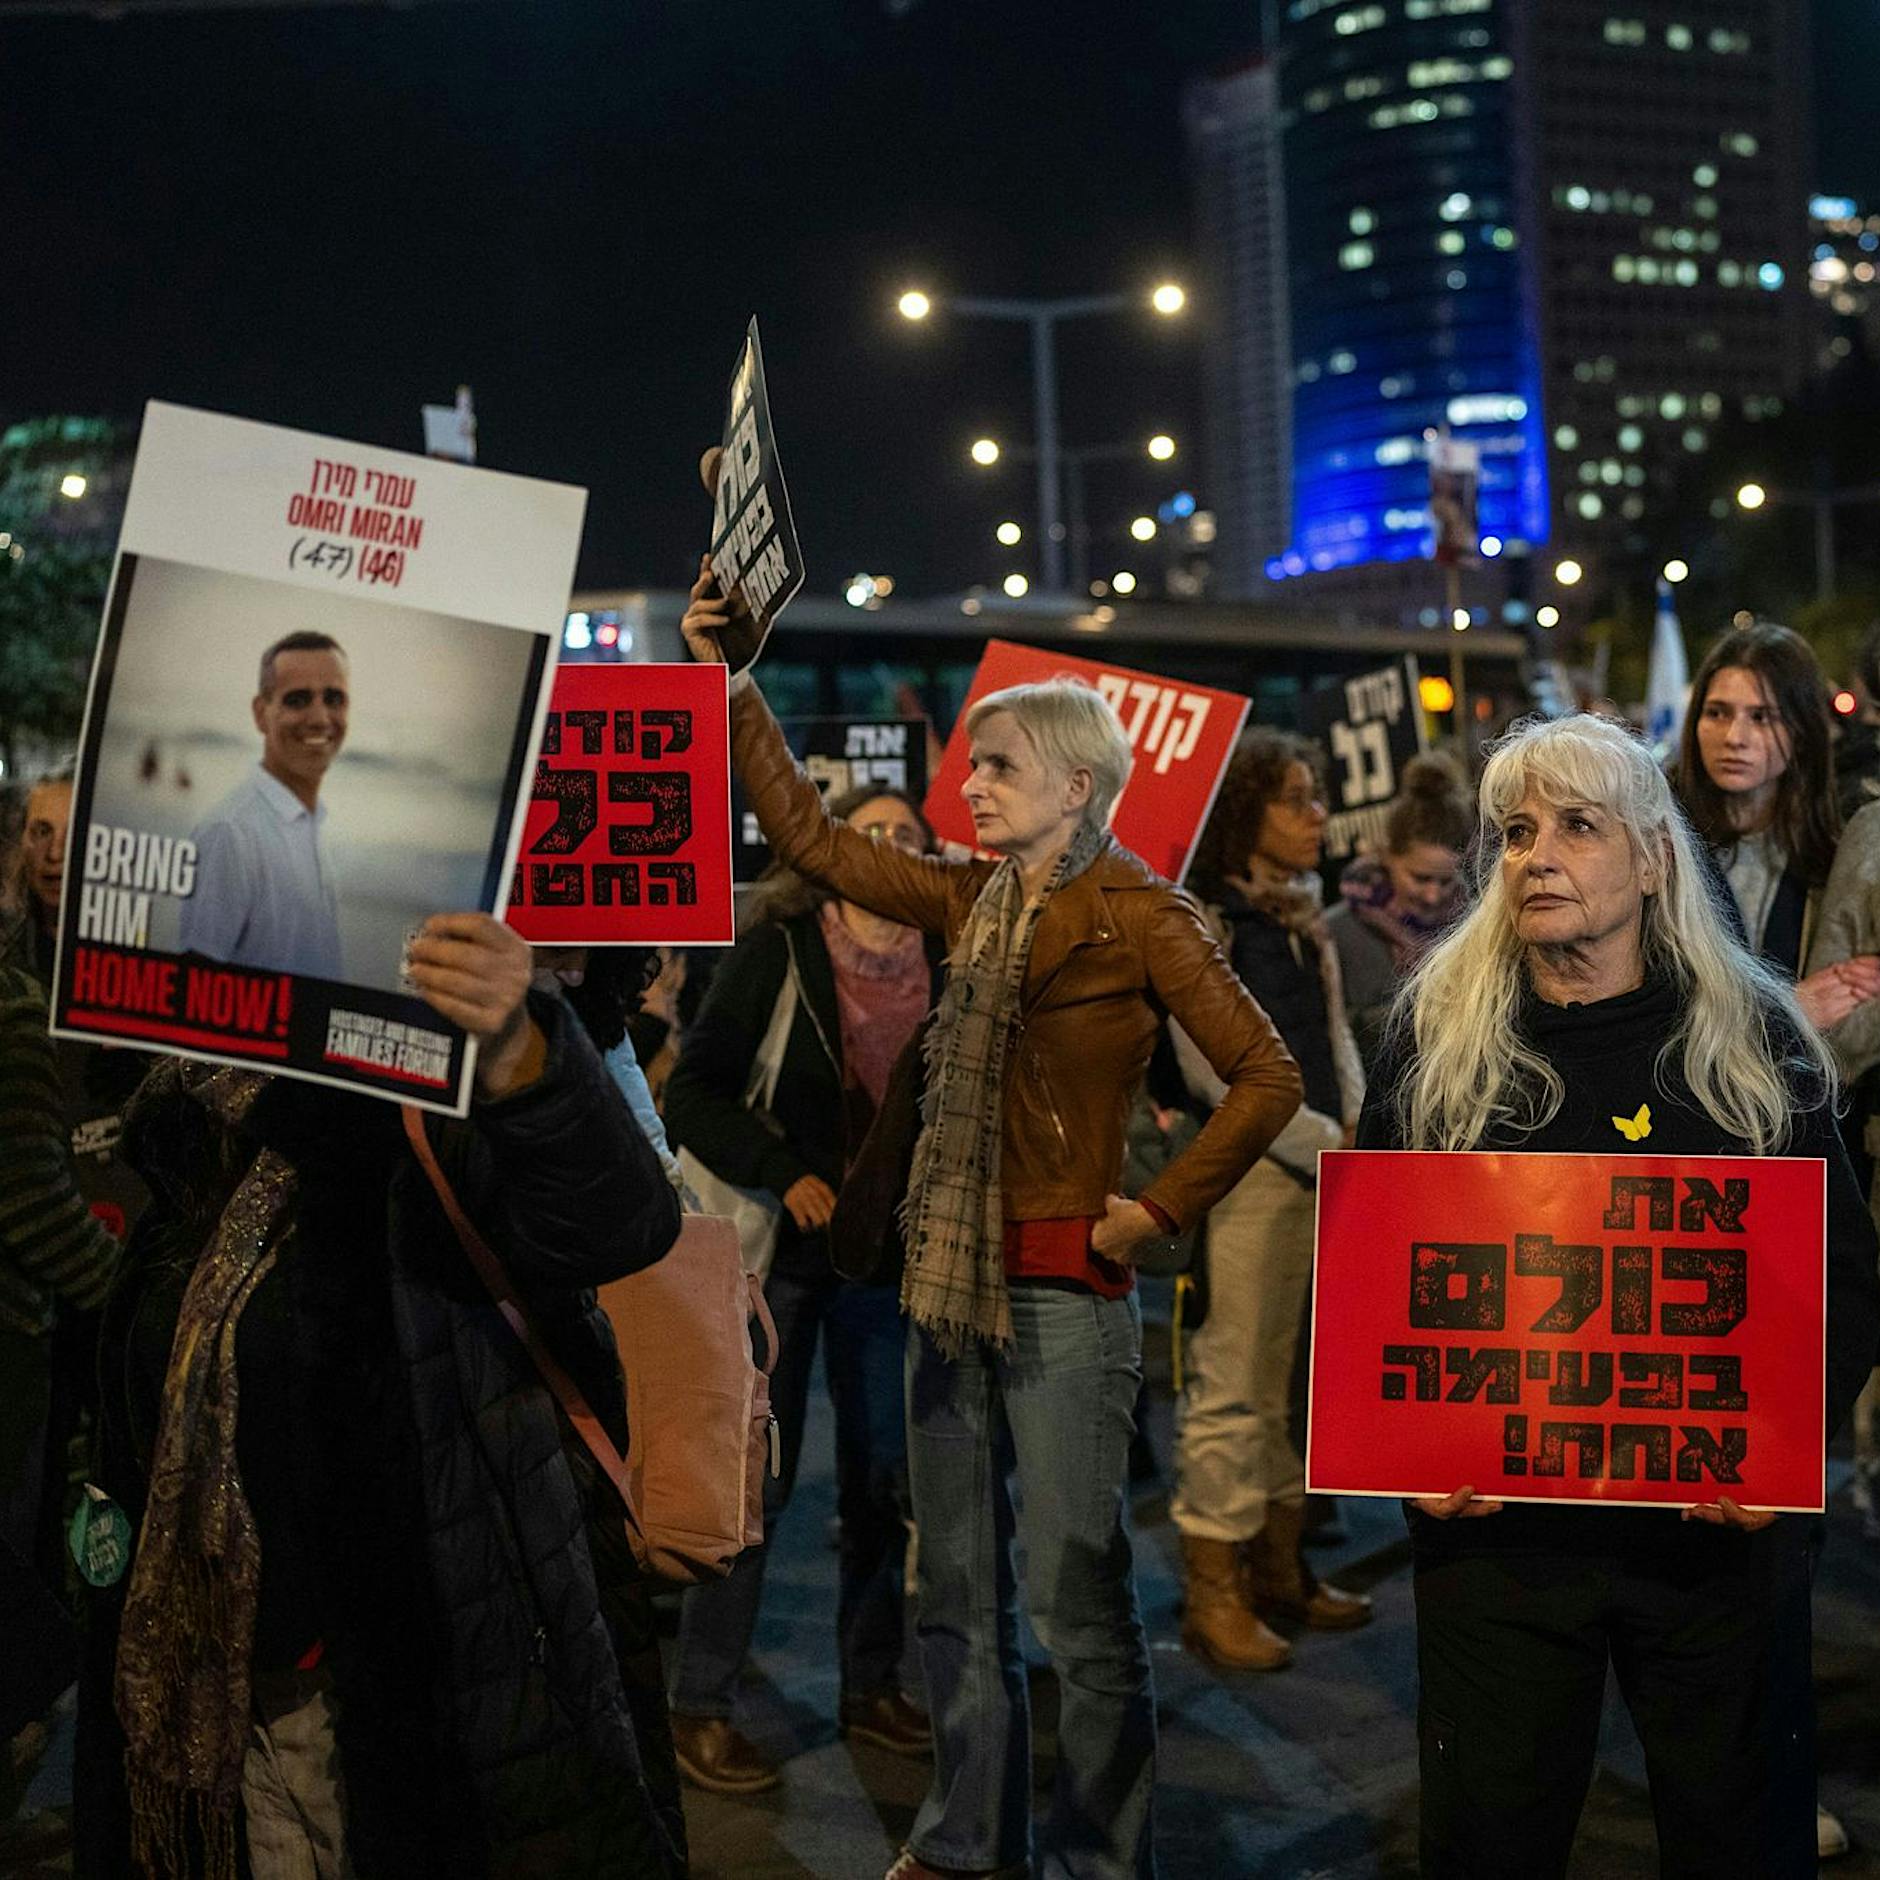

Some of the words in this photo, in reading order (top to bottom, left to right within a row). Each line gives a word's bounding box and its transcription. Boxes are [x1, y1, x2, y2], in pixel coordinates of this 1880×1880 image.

[311, 459, 357, 499] מירן
[364, 468, 416, 509] עמרי
[711, 404, 760, 549] כול
[288, 493, 346, 535] OMRI
[349, 506, 423, 550] MIRAN
[289, 536, 354, 579] (47)
[844, 724, 907, 757] את
[1331, 719, 1394, 808] כל
[528, 760, 692, 856] כל
[806, 754, 908, 800] כול
[84, 823, 197, 897] BRING
[77, 883, 149, 950] HIM
[73, 946, 178, 1027] HOME
[185, 965, 293, 1038] NOW!
[325, 1026, 397, 1070] FAMILIES
[395, 1042, 451, 1082] FORUM
[1603, 1176, 1750, 1233] את
[1409, 1233, 1747, 1337] כולם
[1381, 1344, 1748, 1411] בפעימה
[1503, 1414, 1747, 1484] אחת!
